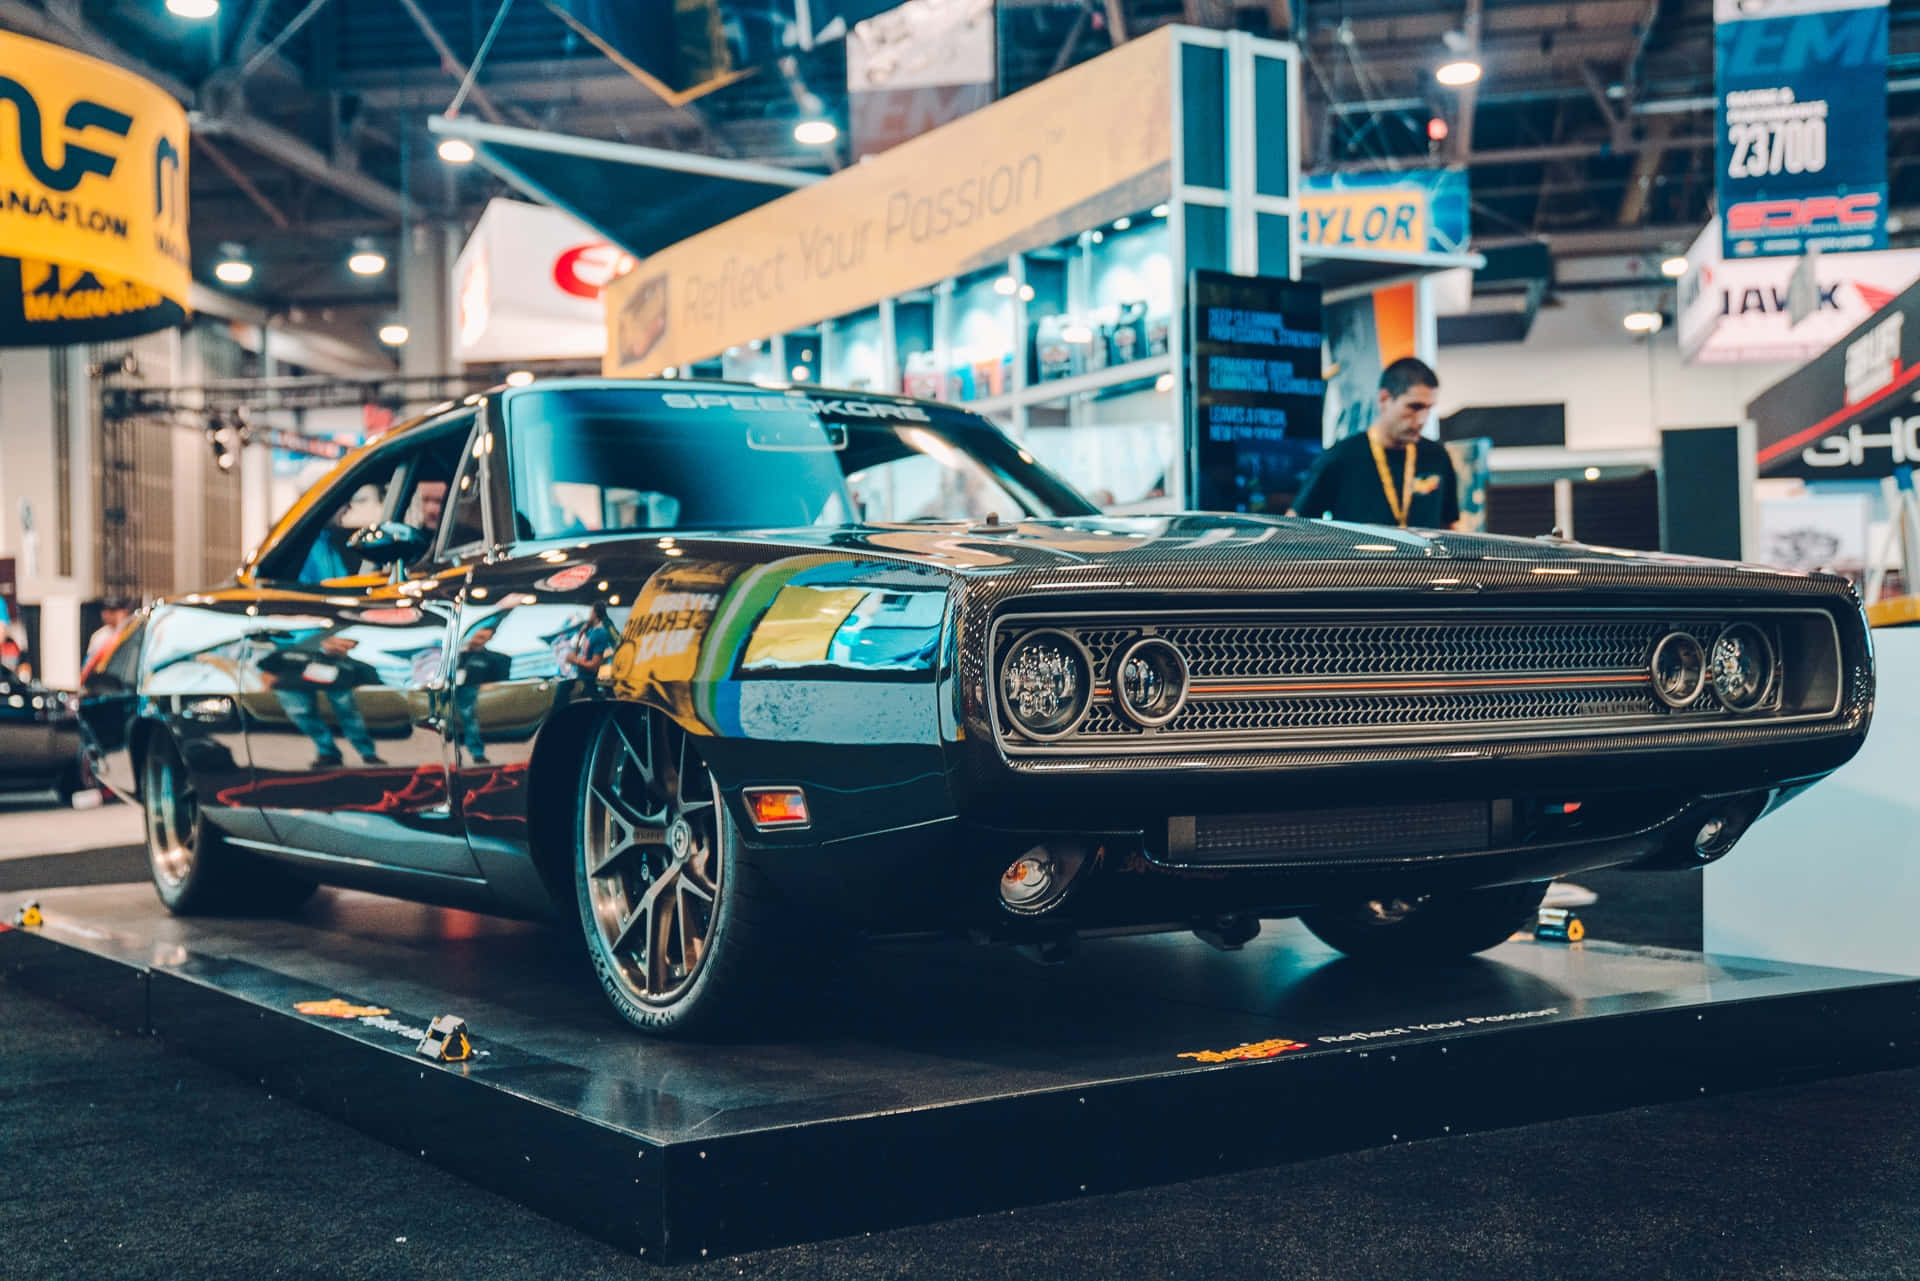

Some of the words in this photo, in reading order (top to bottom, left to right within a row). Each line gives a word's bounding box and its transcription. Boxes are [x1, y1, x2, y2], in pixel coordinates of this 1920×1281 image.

[1728, 117, 1827, 178] 23700
[0, 188, 129, 238] NAFLOW
[682, 248, 788, 327] Reflect
[799, 217, 873, 282] Your
[885, 152, 1043, 253] Passion
[1802, 415, 1920, 468] SH
